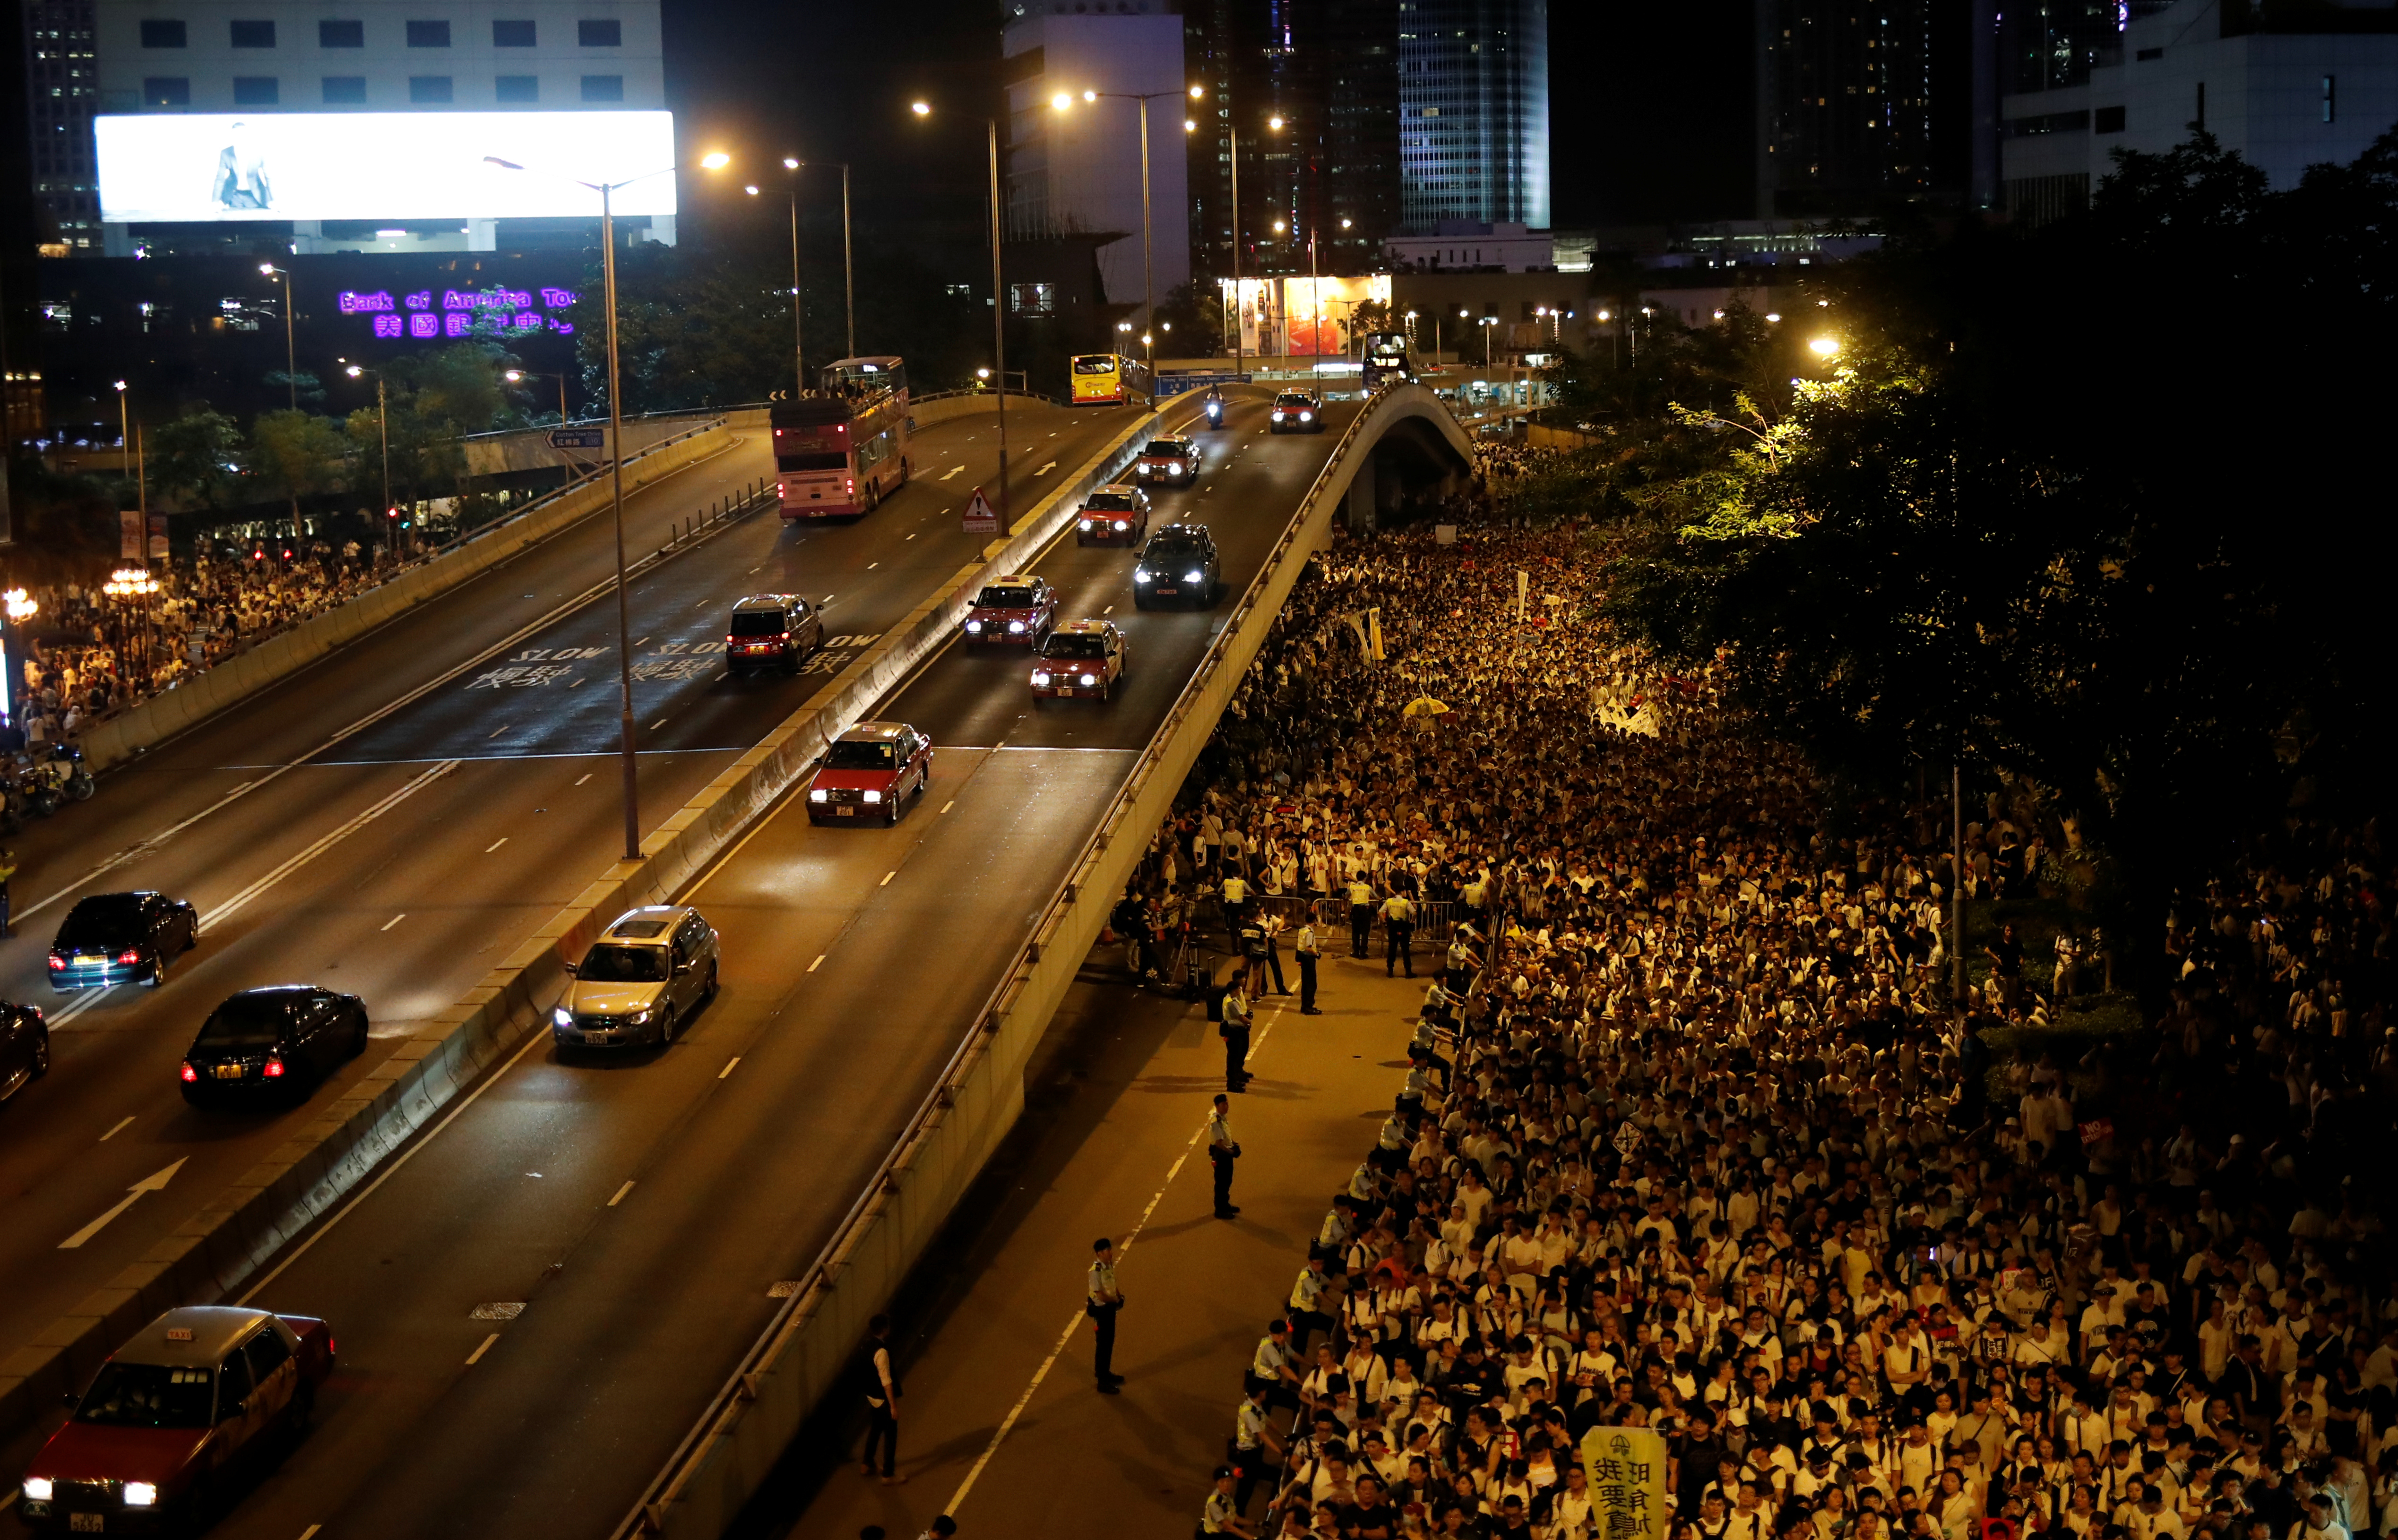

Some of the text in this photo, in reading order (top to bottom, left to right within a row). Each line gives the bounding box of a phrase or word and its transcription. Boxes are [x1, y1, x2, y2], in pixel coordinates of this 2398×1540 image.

[341, 292, 395, 311] Bank
[406, 293, 432, 309] of
[444, 290, 533, 310] America
[509, 646, 611, 662] SLOW
[464, 664, 573, 690] 慢駛
[619, 658, 717, 681] 慢駛
[2084, 1120, 2101, 1135] NO
[80, 1514, 94, 1523] JU
